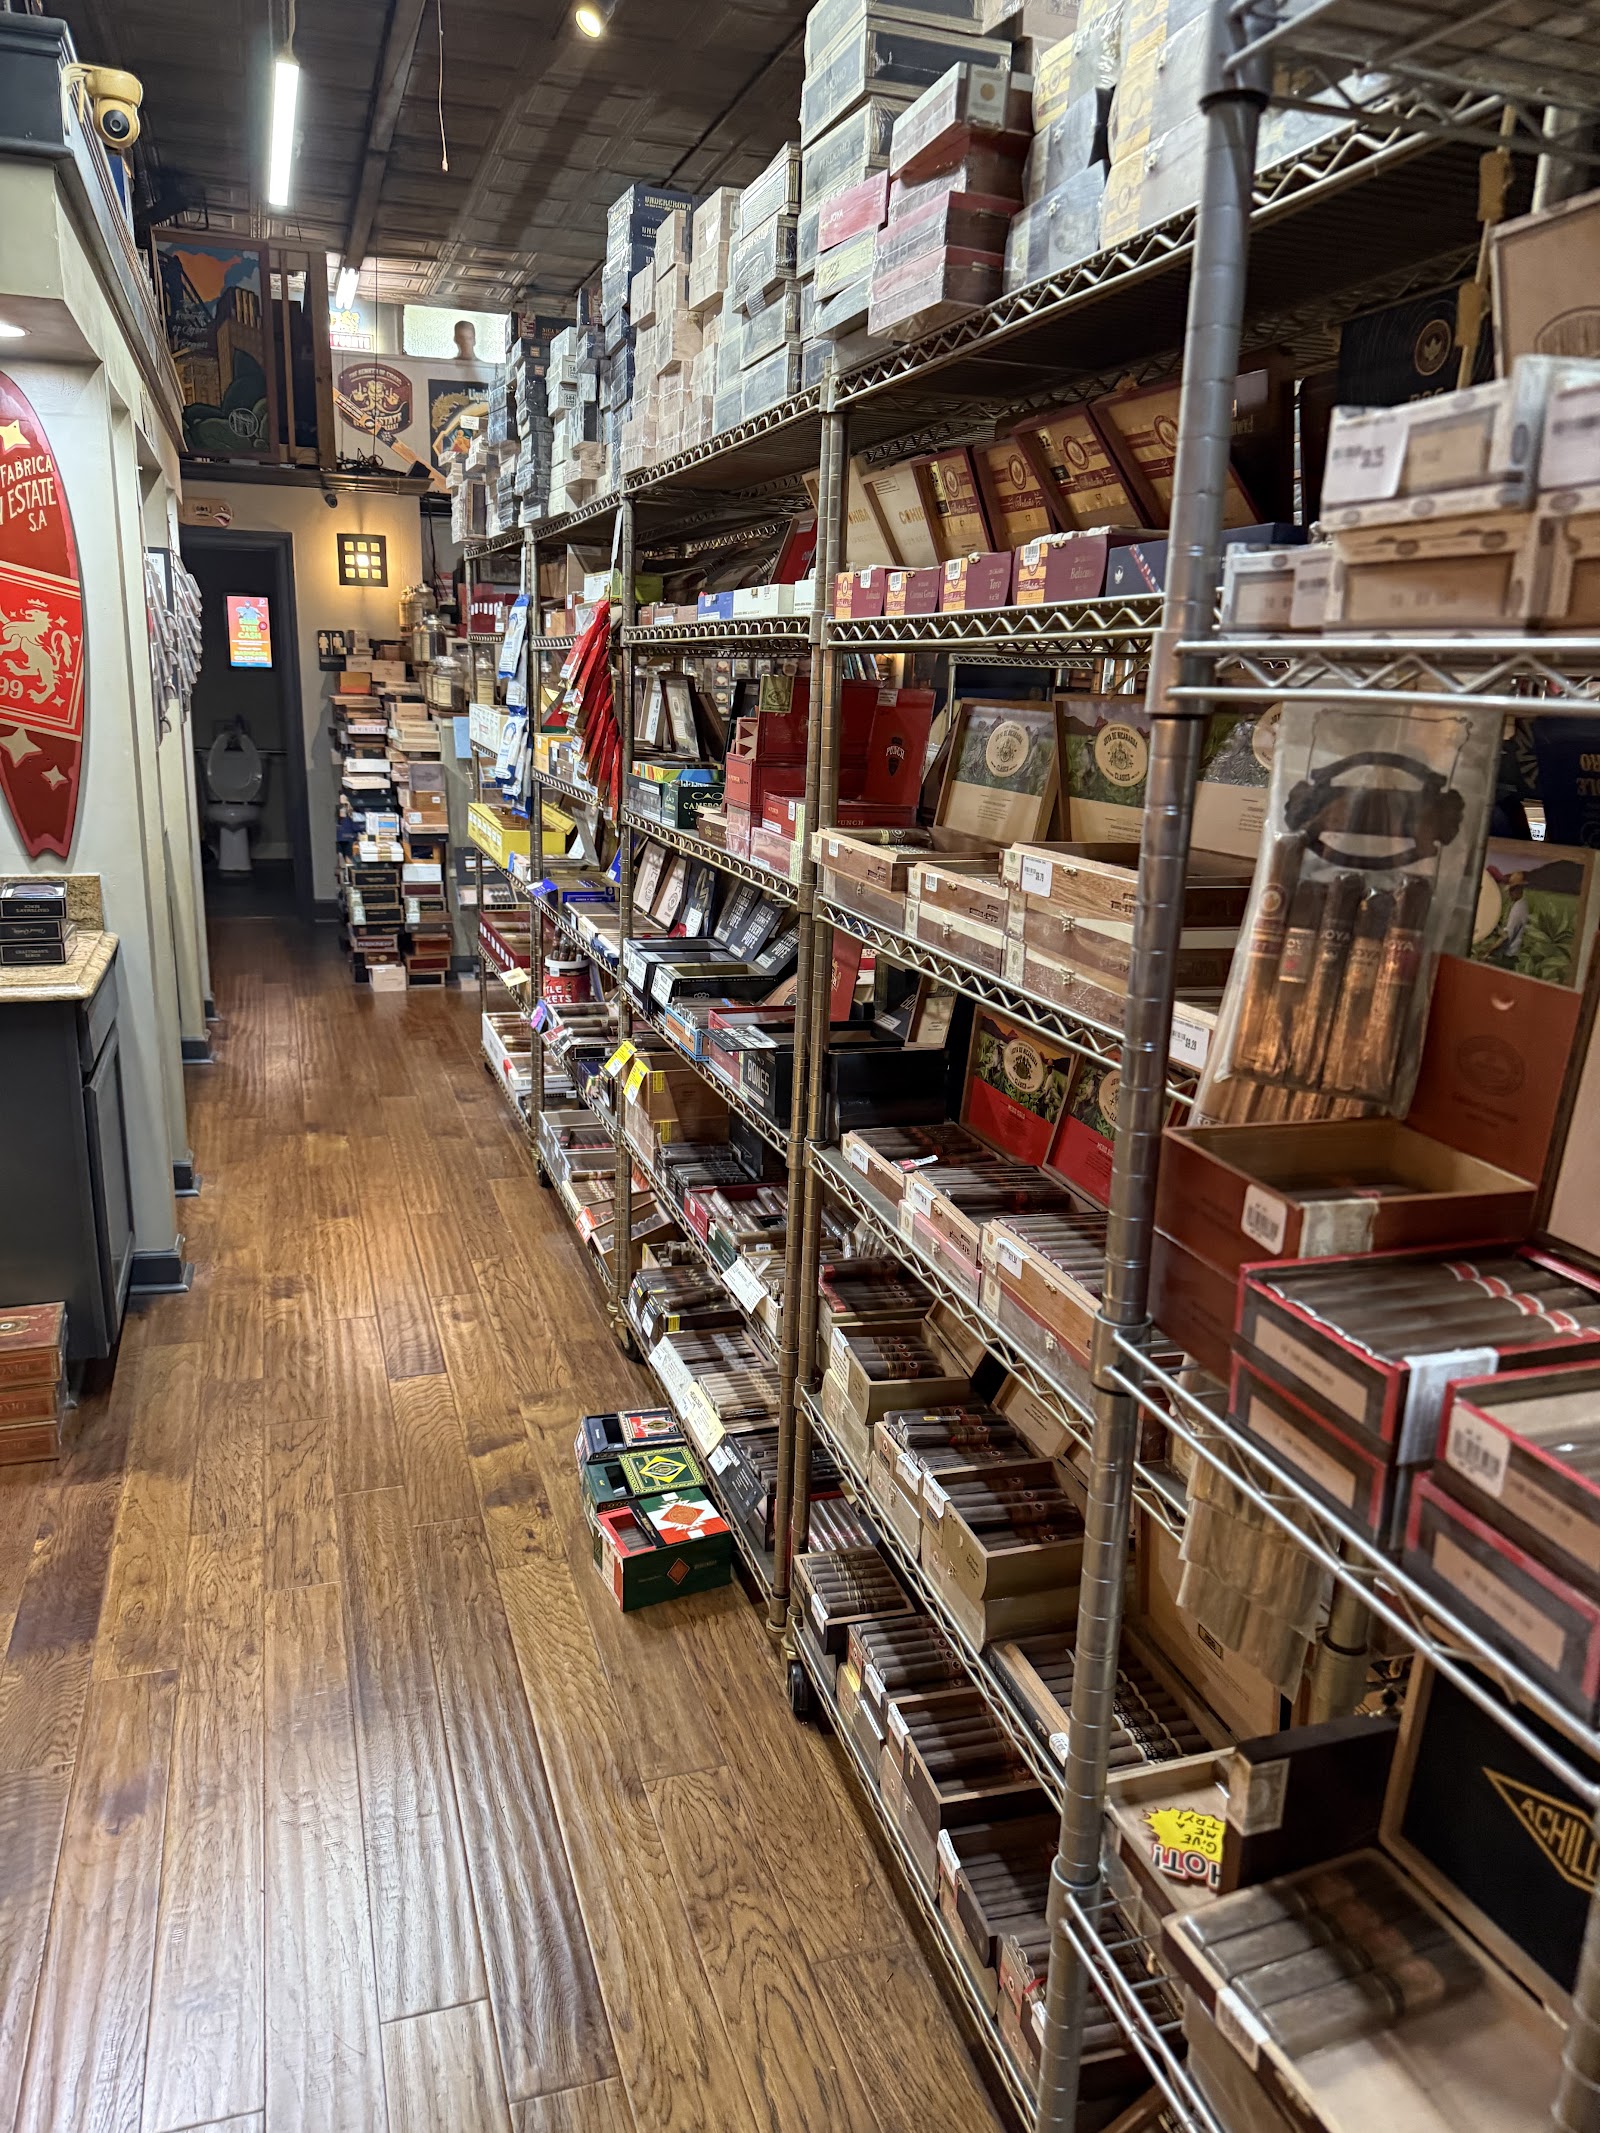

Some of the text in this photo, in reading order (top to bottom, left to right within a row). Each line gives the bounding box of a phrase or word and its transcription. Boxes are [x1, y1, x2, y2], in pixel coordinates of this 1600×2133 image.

[644, 195, 692, 211] UNDERCROWN
[829, 210, 844, 222] JOYA
[0, 454, 54, 489] FABRICA
[8, 476, 57, 520] ESTATE
[849, 509, 871, 525] OHIBA
[898, 506, 926, 525] COHIB
[989, 578, 1002, 590] Toro
[1117, 731, 1138, 749] NICARAGUA
[885, 745, 905, 760] PUNCH
[691, 791, 724, 801] CAO
[838, 819, 864, 827] UNCH
[732, 903, 747, 918] EVERY
[748, 921, 765, 938] EVERY
[780, 934, 800, 949] EVERY
[747, 1058, 770, 1096] BONES
[1175, 1821, 1217, 1839] ME A
[1178, 1812, 1220, 1831] TRY!
[1520, 1798, 1596, 1880] ACHILL
[1153, 1845, 1221, 1885] HOT!
